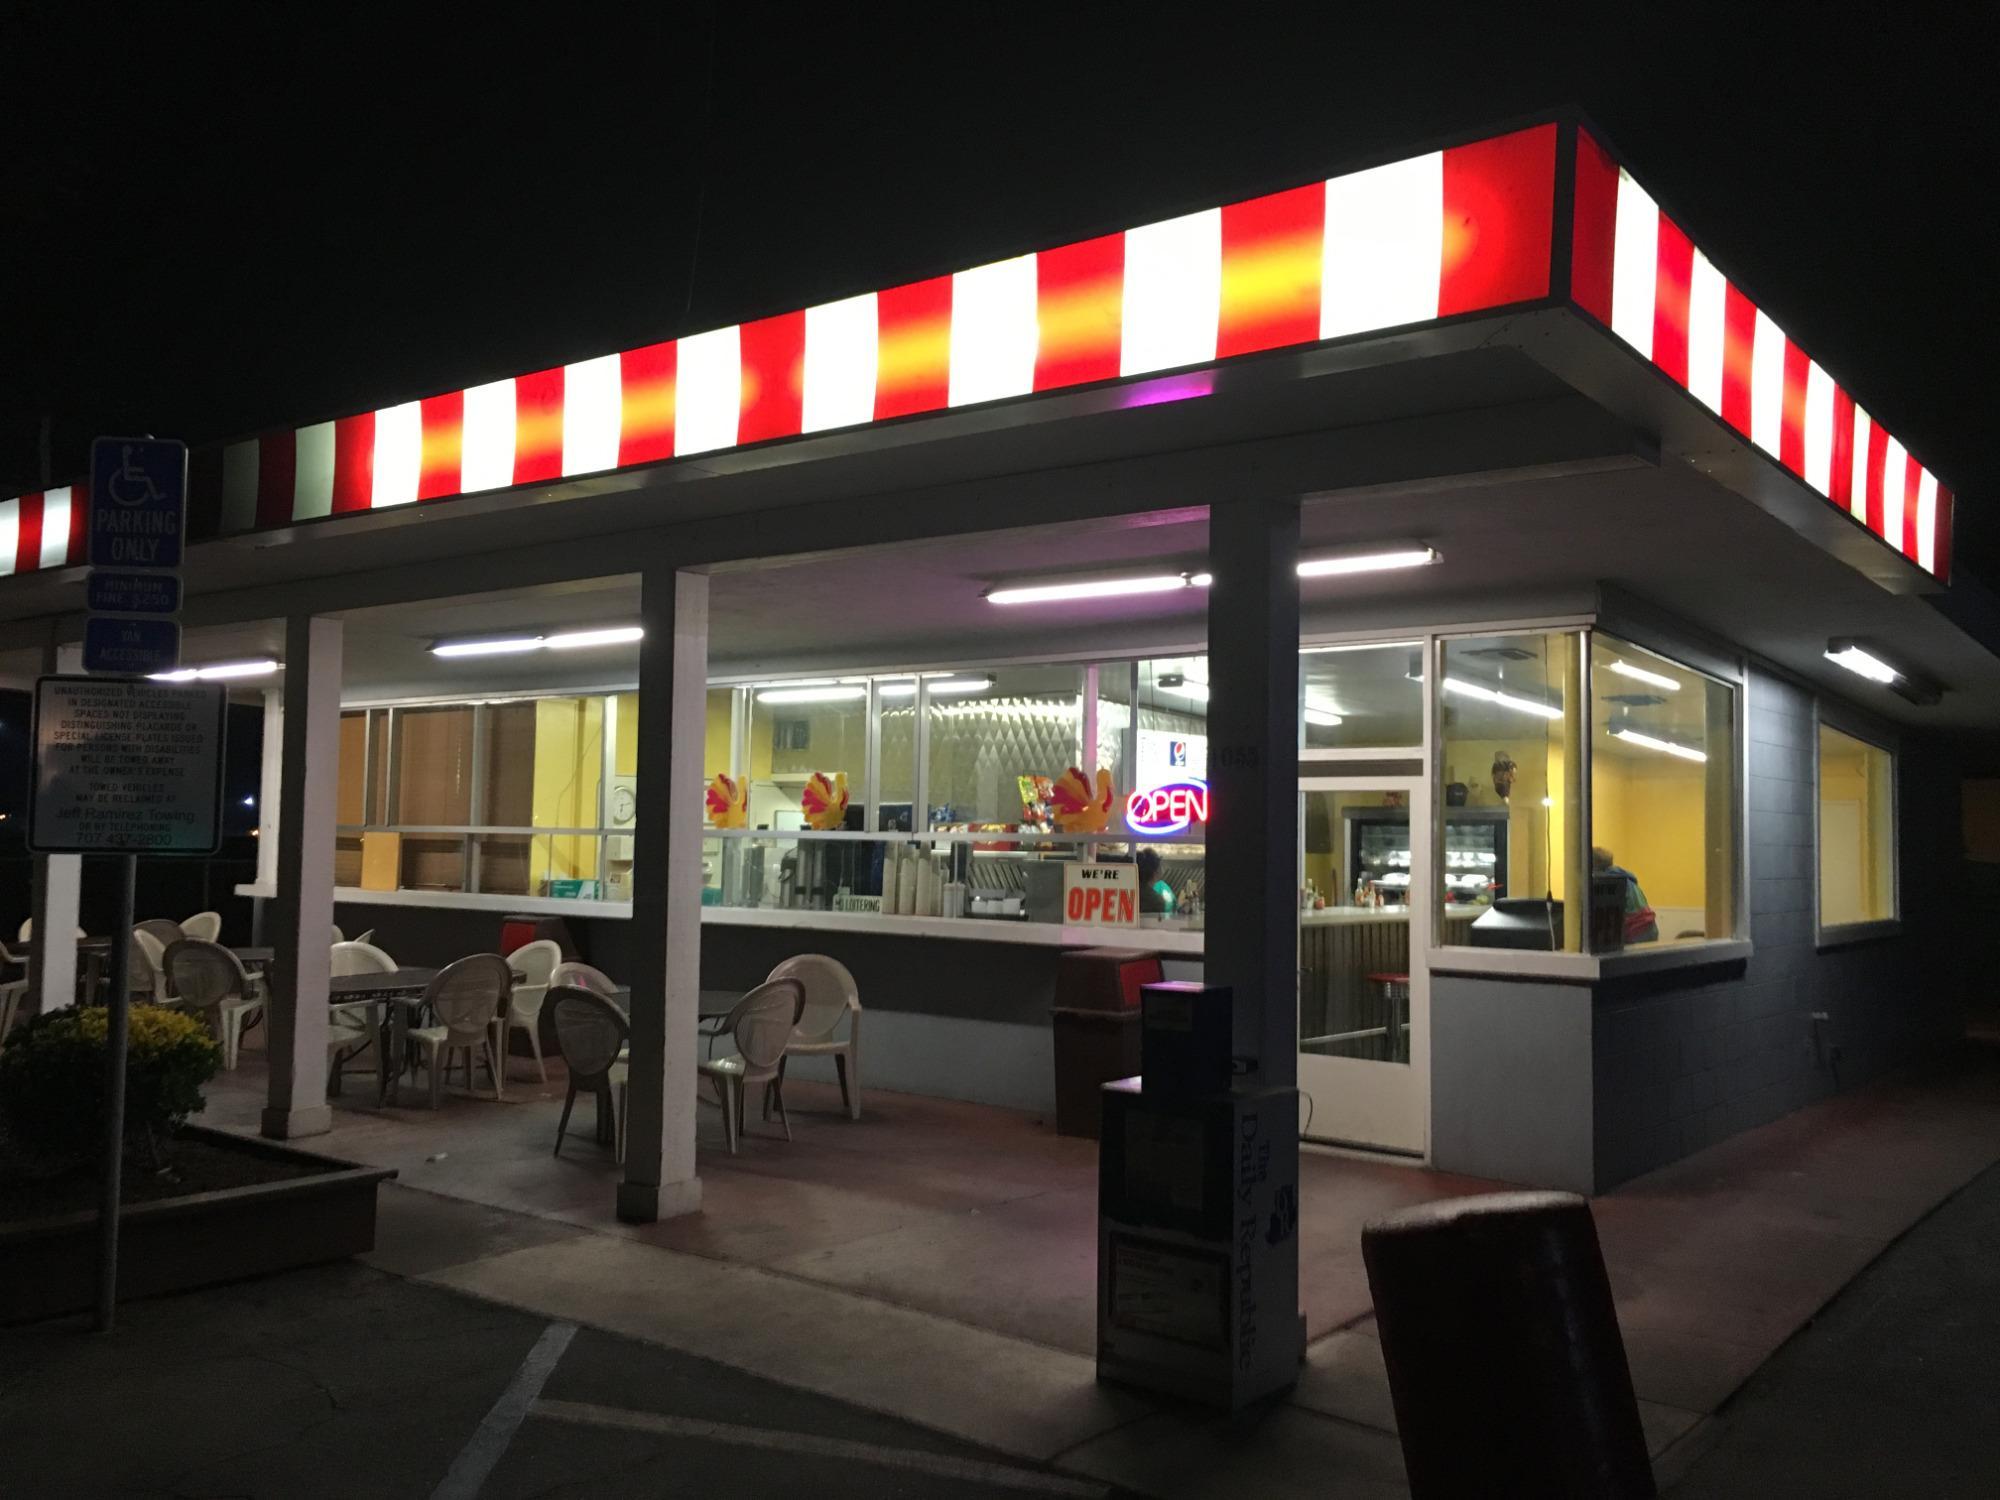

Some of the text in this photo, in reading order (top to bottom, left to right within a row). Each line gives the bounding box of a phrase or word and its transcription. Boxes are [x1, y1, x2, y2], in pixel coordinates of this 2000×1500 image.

[96, 510, 176, 535] PARKING
[112, 537, 160, 560] ONLY
[54, 687, 123, 697] UNAUTHORIZED
[126, 687, 169, 698] VEHICLES
[68, 698, 192, 709] IN DESIGNATED ACCESSIBLE
[74, 709, 185, 721] SPACES NOT DISPLAYING
[61, 720, 197, 732] DISTINGUISHING PLACARDS OR
[54, 731, 203, 743] SPECIAL LICENSE PLATES ISSUED
[55, 743, 200, 754] FOR PERSONS WITH DISABILITIES
[81, 755, 175, 765] WILL BE TOWED AWAY
[70, 765, 184, 777] AT THE OWNER'S EXPENSE
[89, 782, 165, 792] TOWED VEHICLES
[75, 794, 93, 802] MAY
[97, 794, 109, 803] BE
[112, 794, 164, 803] RECLAIMED
[1127, 788, 1209, 823] OPEN
[56, 806, 195, 824] Jeff Ramirez Towing
[79, 822, 171, 832] OR BY TELEPHONING
[77, 832, 102, 843] 707
[1081, 869, 1120, 879] WE'RE
[845, 898, 880, 912] LOITERING
[1068, 886, 1135, 923] OPEN
[1258, 1140, 1270, 1182] The
[1237, 1114, 1258, 1370] Daily Republic
